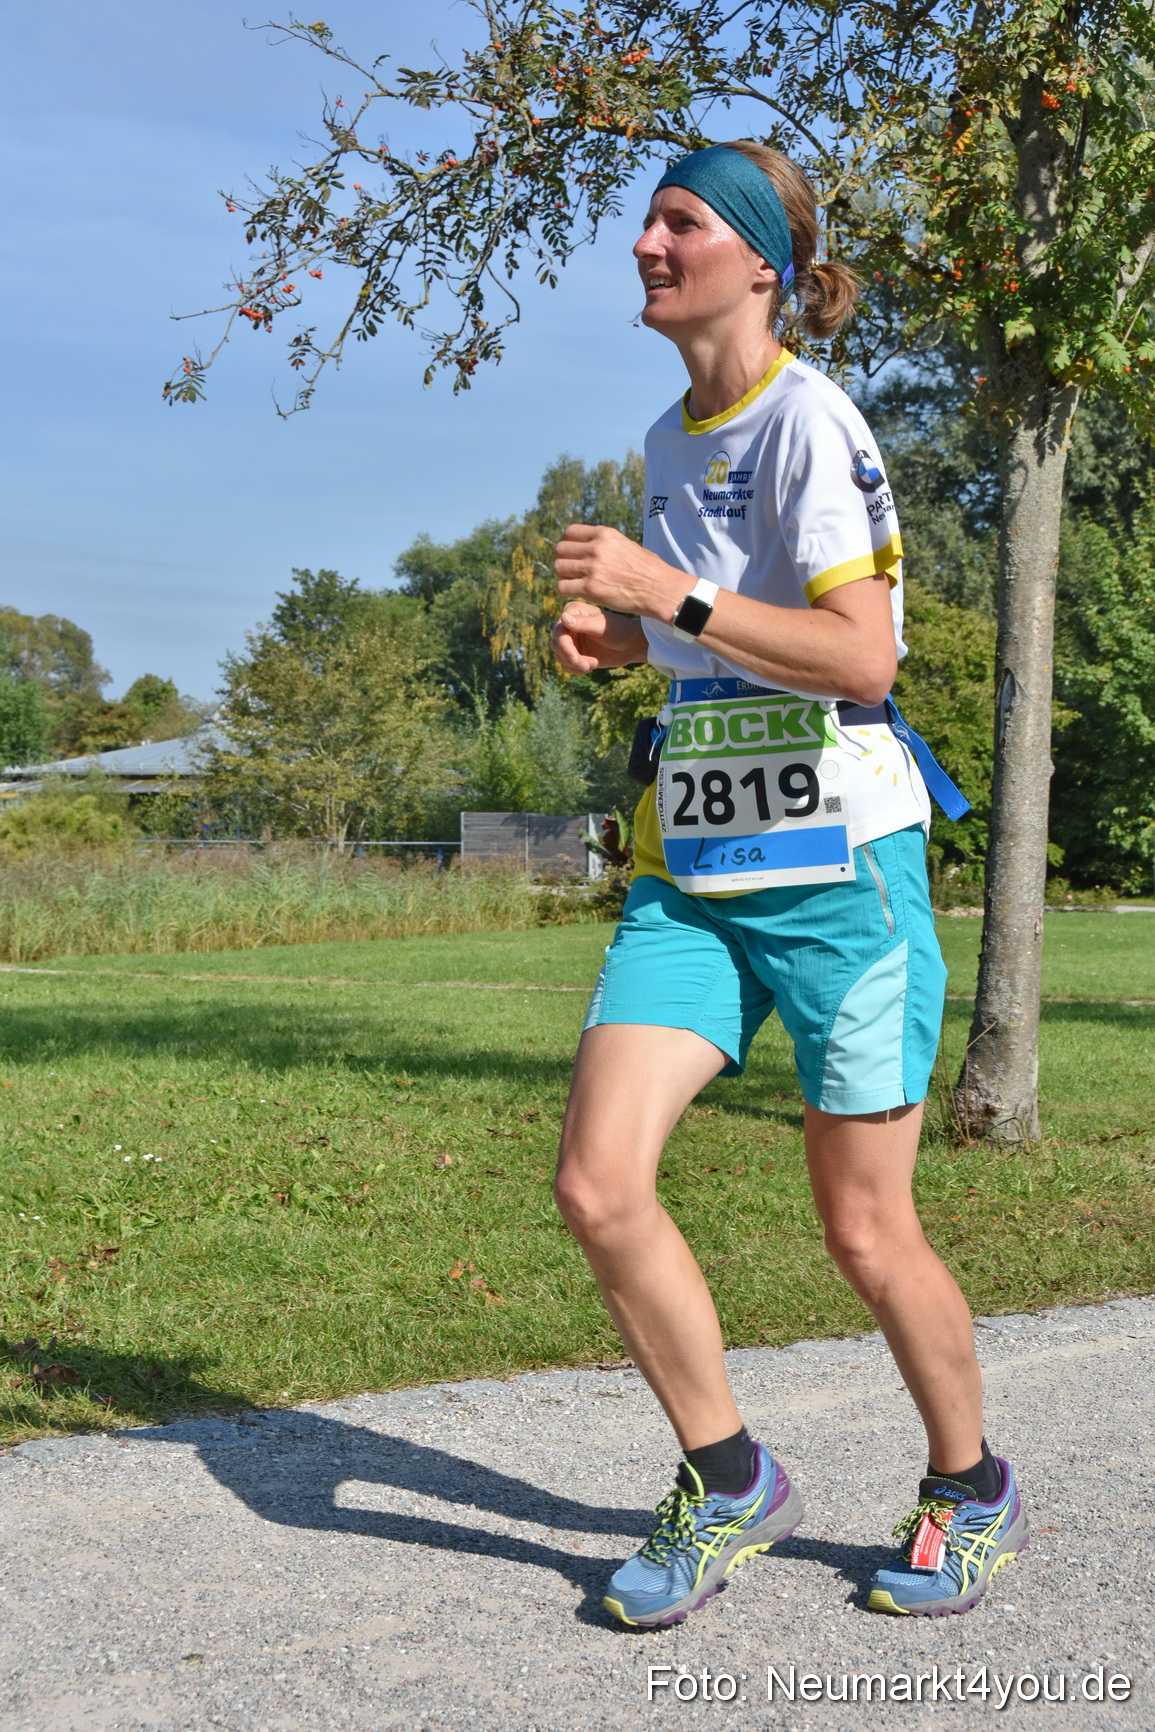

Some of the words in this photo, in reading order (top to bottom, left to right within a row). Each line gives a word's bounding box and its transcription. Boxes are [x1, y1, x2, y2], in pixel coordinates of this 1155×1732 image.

[705, 461, 729, 484] 20
[698, 505, 747, 520] Stadtlauf
[669, 706, 815, 751] BOCK
[672, 763, 820, 826] 2819
[692, 837, 766, 870] Lisa
[913, 1545, 921, 1564] NICHT
